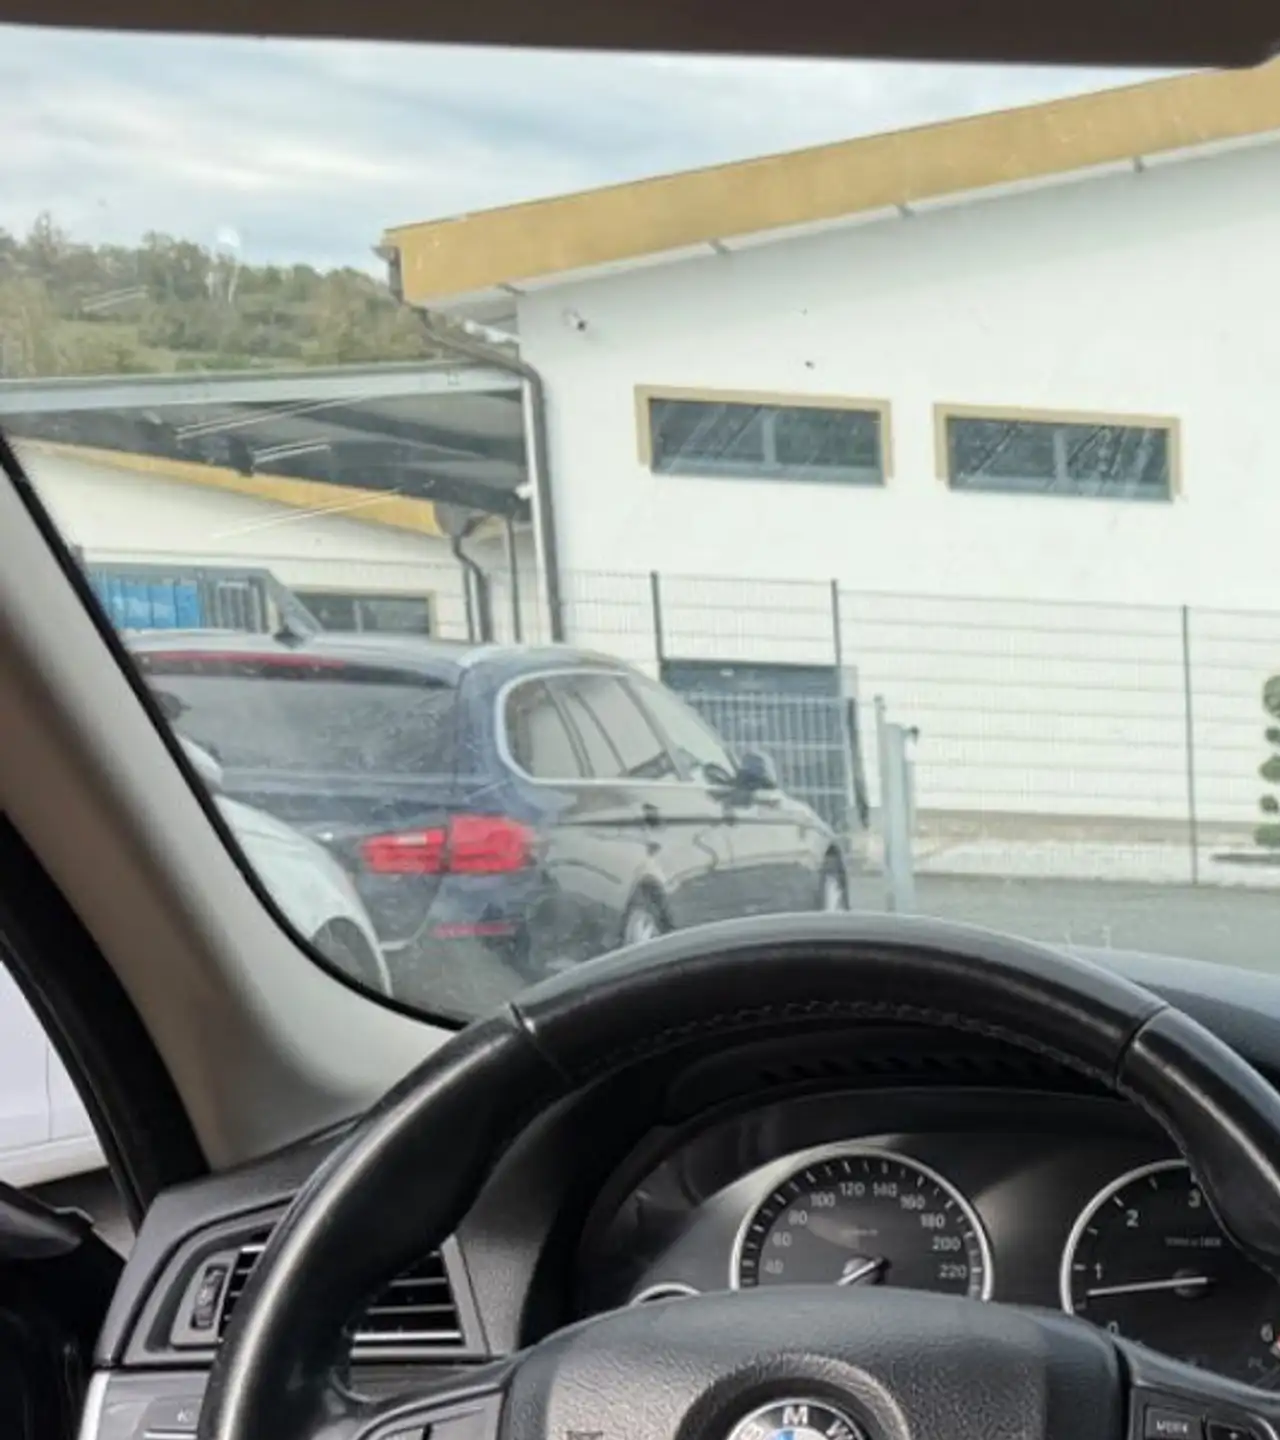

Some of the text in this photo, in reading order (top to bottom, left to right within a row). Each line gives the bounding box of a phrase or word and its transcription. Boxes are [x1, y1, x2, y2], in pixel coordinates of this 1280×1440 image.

[840, 1182, 866, 1195] 120
[872, 1183, 898, 1197] 140
[810, 1193, 836, 1207] 100
[1188, 1189, 1201, 1208] 3
[789, 1211, 808, 1224] 80
[920, 1214, 946, 1228] 180
[1125, 1209, 1139, 1228] 2
[772, 1232, 792, 1247] 60
[933, 1236, 961, 1250] 200
[939, 1264, 967, 1278] 220
[1094, 1262, 1102, 1280] 1
[1260, 1323, 1274, 1343] 6
